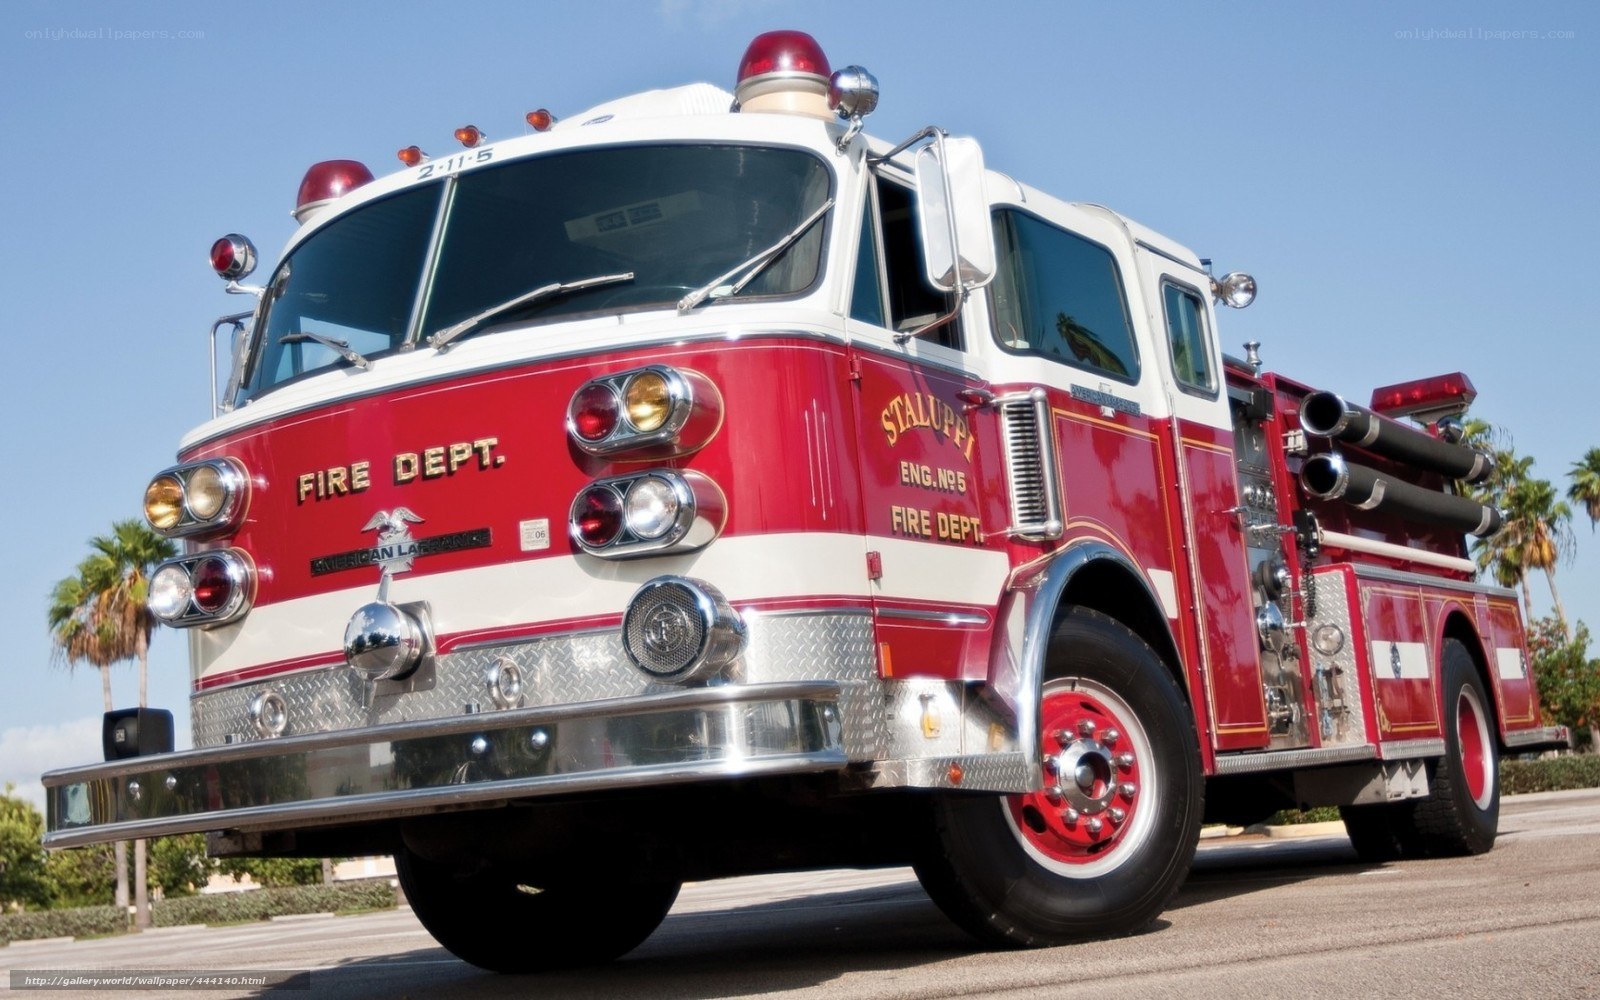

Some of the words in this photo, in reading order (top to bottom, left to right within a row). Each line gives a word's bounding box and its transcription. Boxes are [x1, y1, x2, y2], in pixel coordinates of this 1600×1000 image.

[881, 392, 975, 463] STALUPPI
[298, 461, 371, 504] FIRE
[395, 437, 505, 485] DEPT.
[535, 530, 546, 539] 06
[891, 505, 932, 537] FIRE
